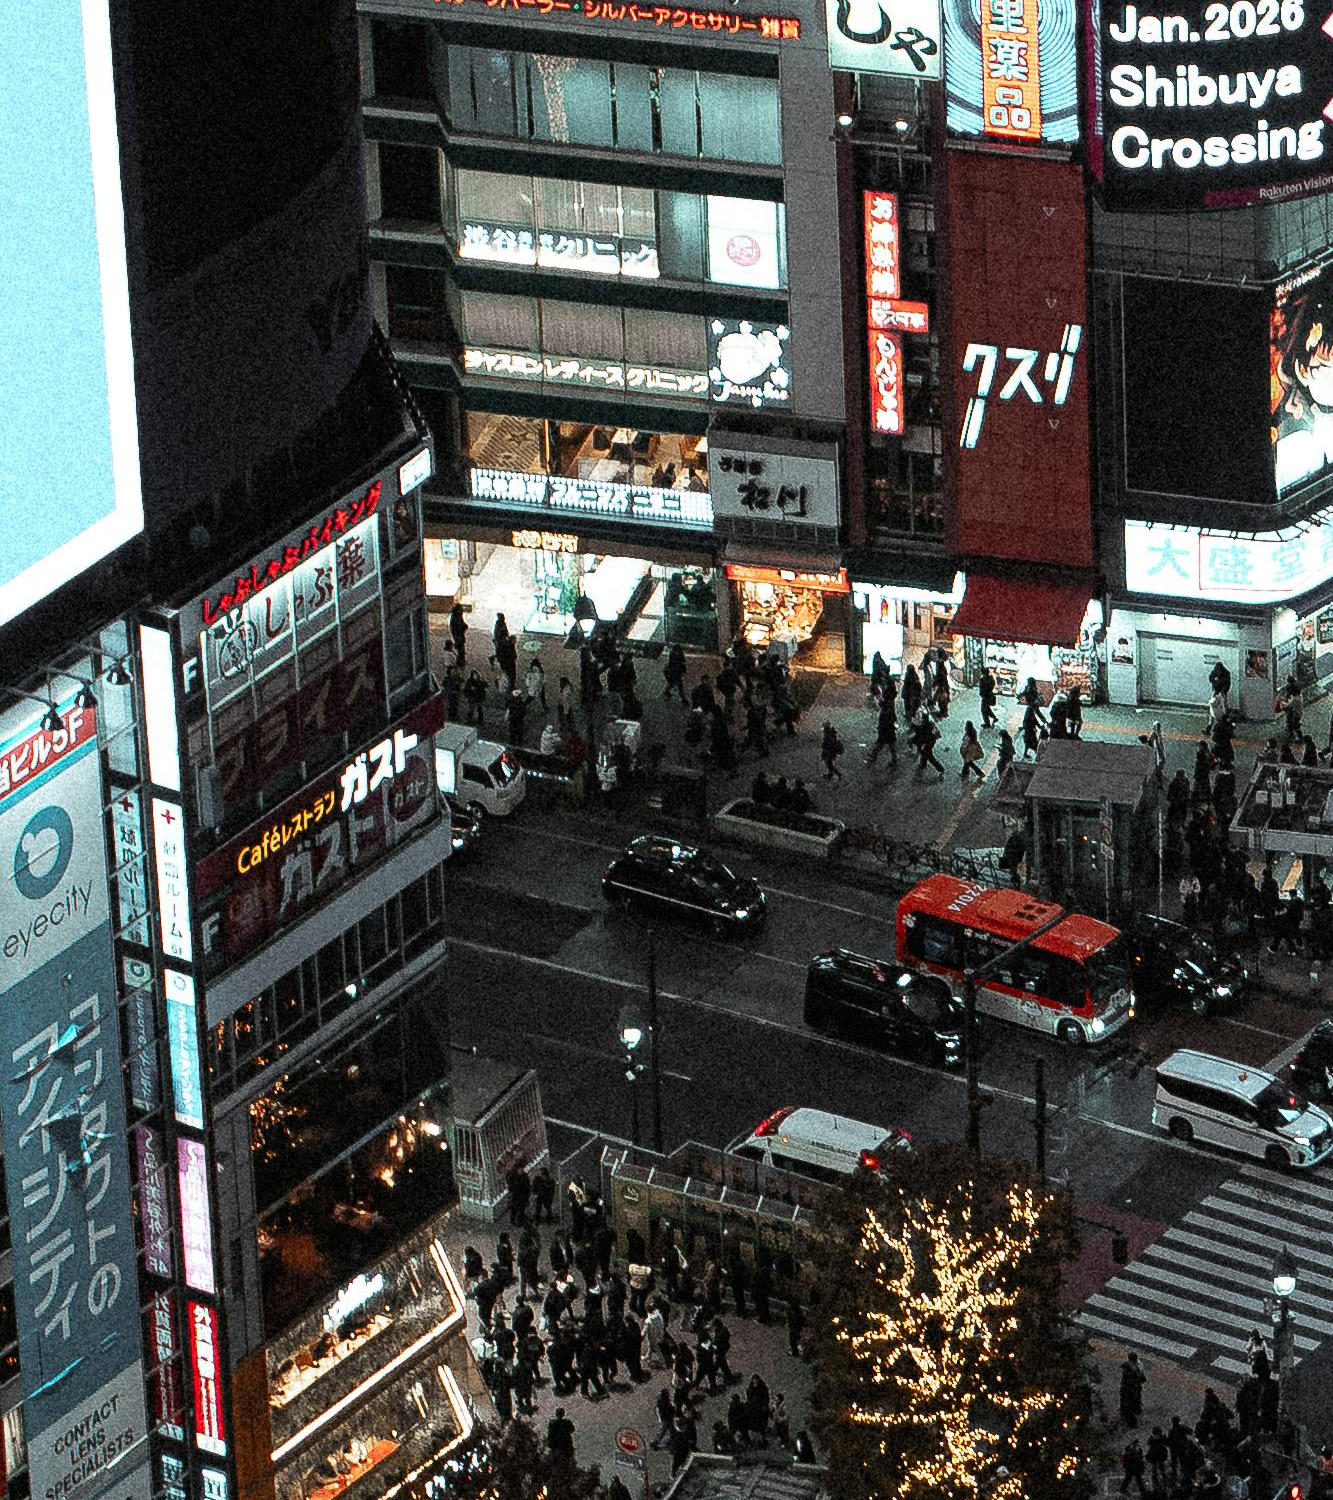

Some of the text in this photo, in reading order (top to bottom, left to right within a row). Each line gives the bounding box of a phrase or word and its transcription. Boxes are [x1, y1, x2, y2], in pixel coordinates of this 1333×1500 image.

[1109, 62, 1302, 109] Shibuya
[1111, 118, 1325, 170] Crossing
[1259, 180, 1301, 201] Rakuten
[340, 728, 418, 813] ガスト
[280, 808, 374, 916] ガスト
[3, 879, 93, 958] eyecity
[52, 1395, 120, 1456] CONTACT
[70, 1427, 106, 1464] LENS
